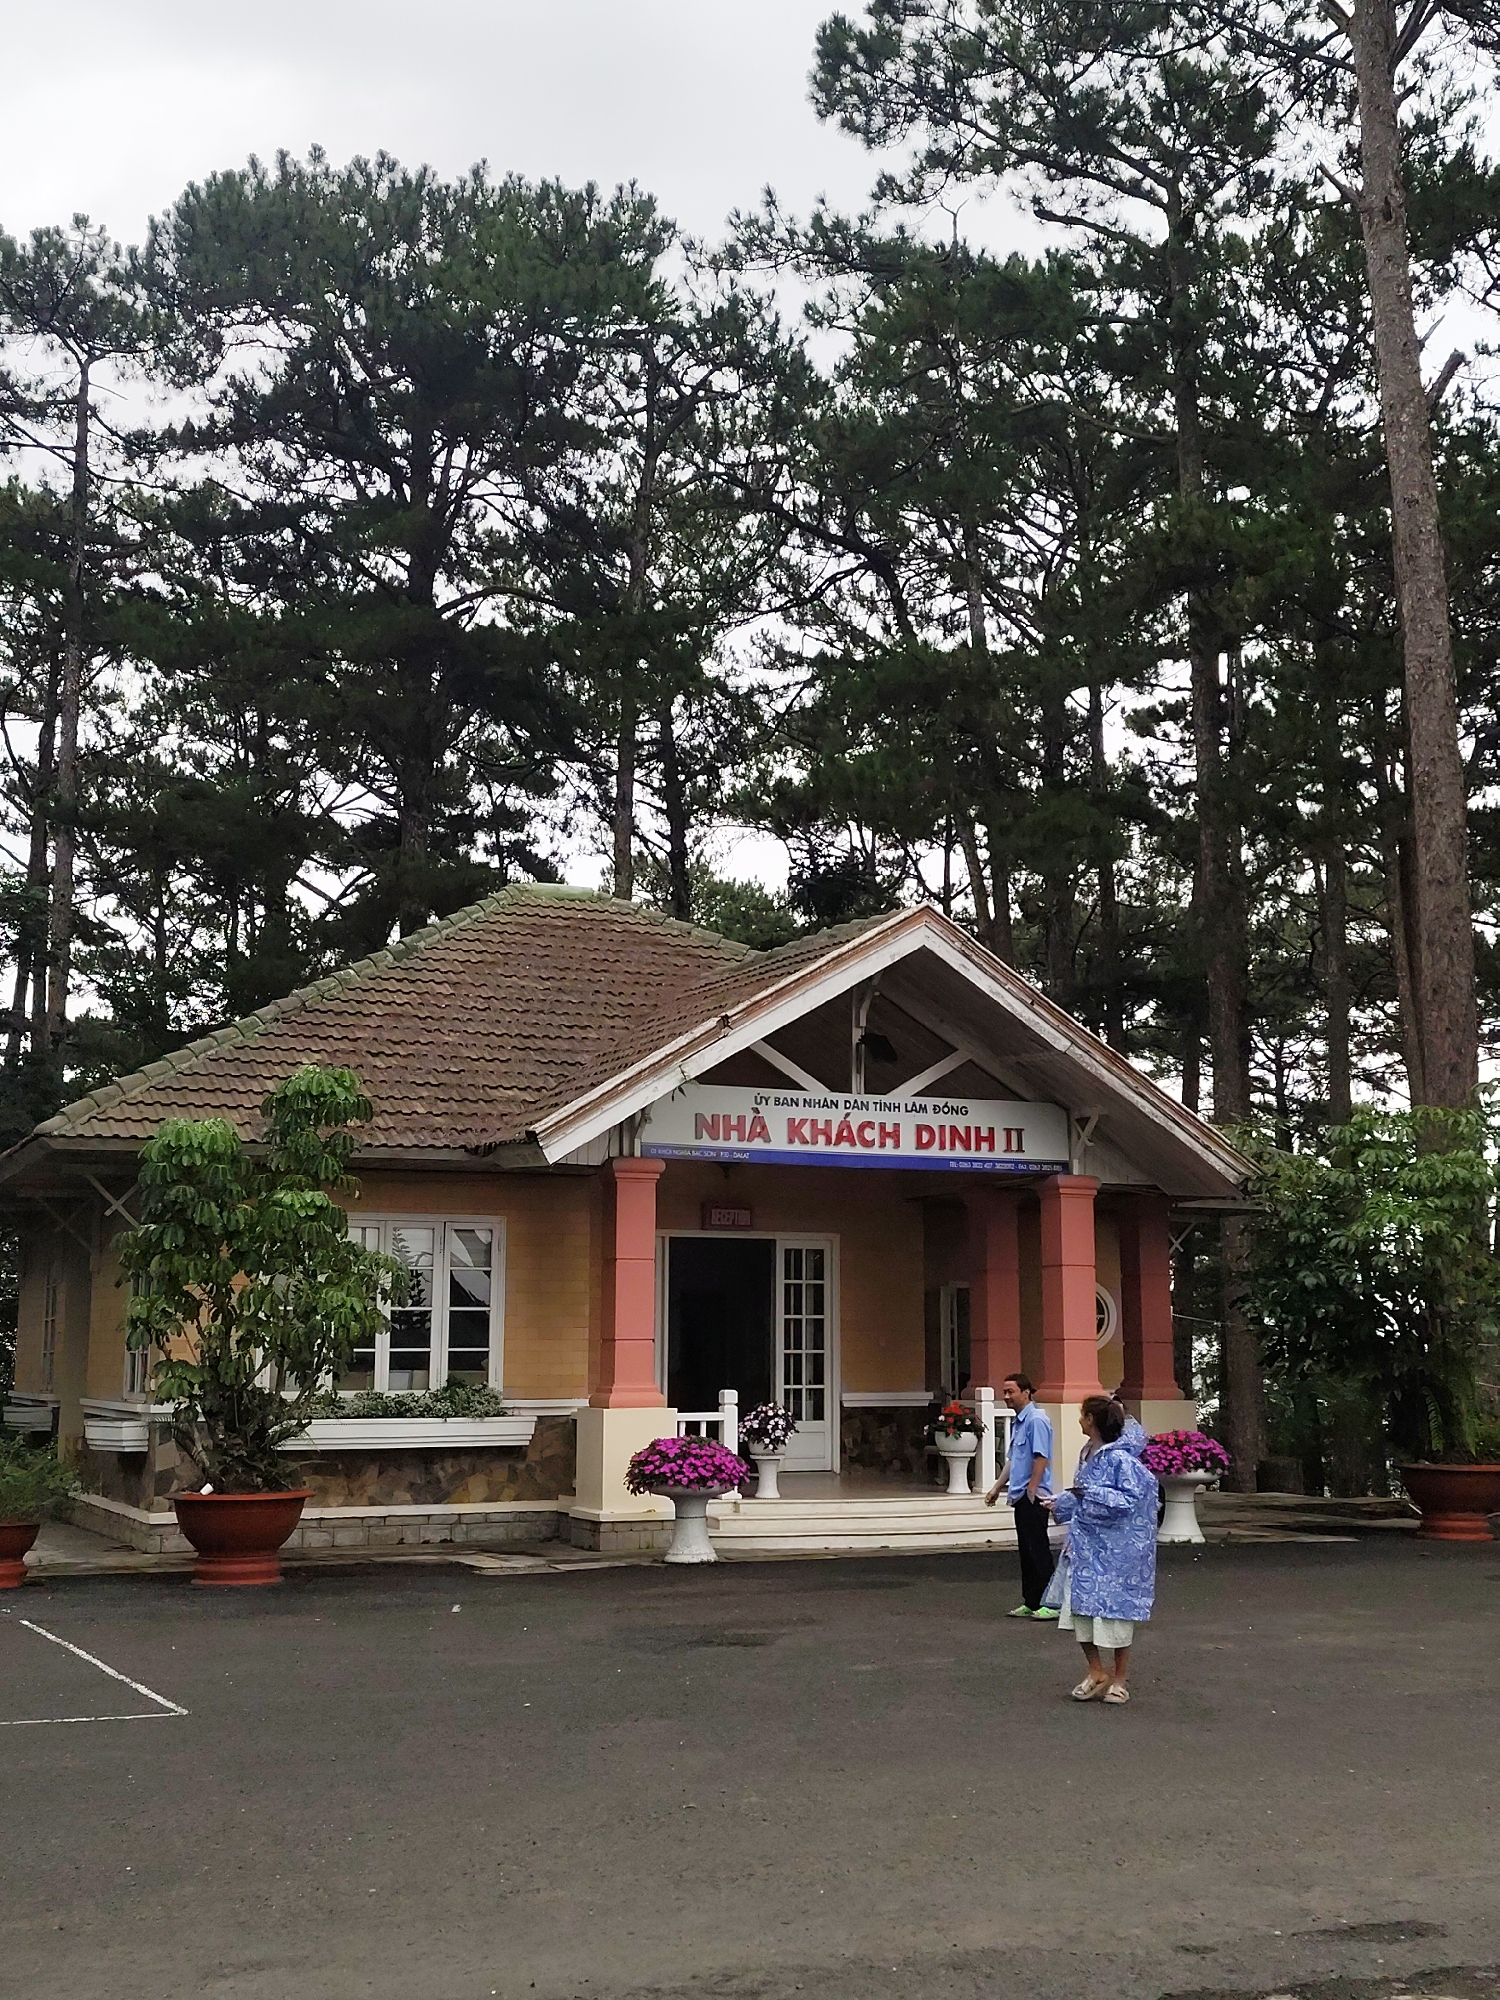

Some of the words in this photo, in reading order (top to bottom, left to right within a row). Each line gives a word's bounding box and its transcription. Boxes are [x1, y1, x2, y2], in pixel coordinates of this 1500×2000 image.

[773, 1096, 800, 1108] BAN
[802, 1096, 839, 1110] NHÂN
[843, 1098, 870, 1112] DÂN
[904, 1100, 928, 1115] LÂM
[694, 1107, 772, 1143] NHÀ
[786, 1112, 901, 1149] KHÁCH
[915, 1124, 996, 1153] DINH
[1002, 1128, 1026, 1154] II
